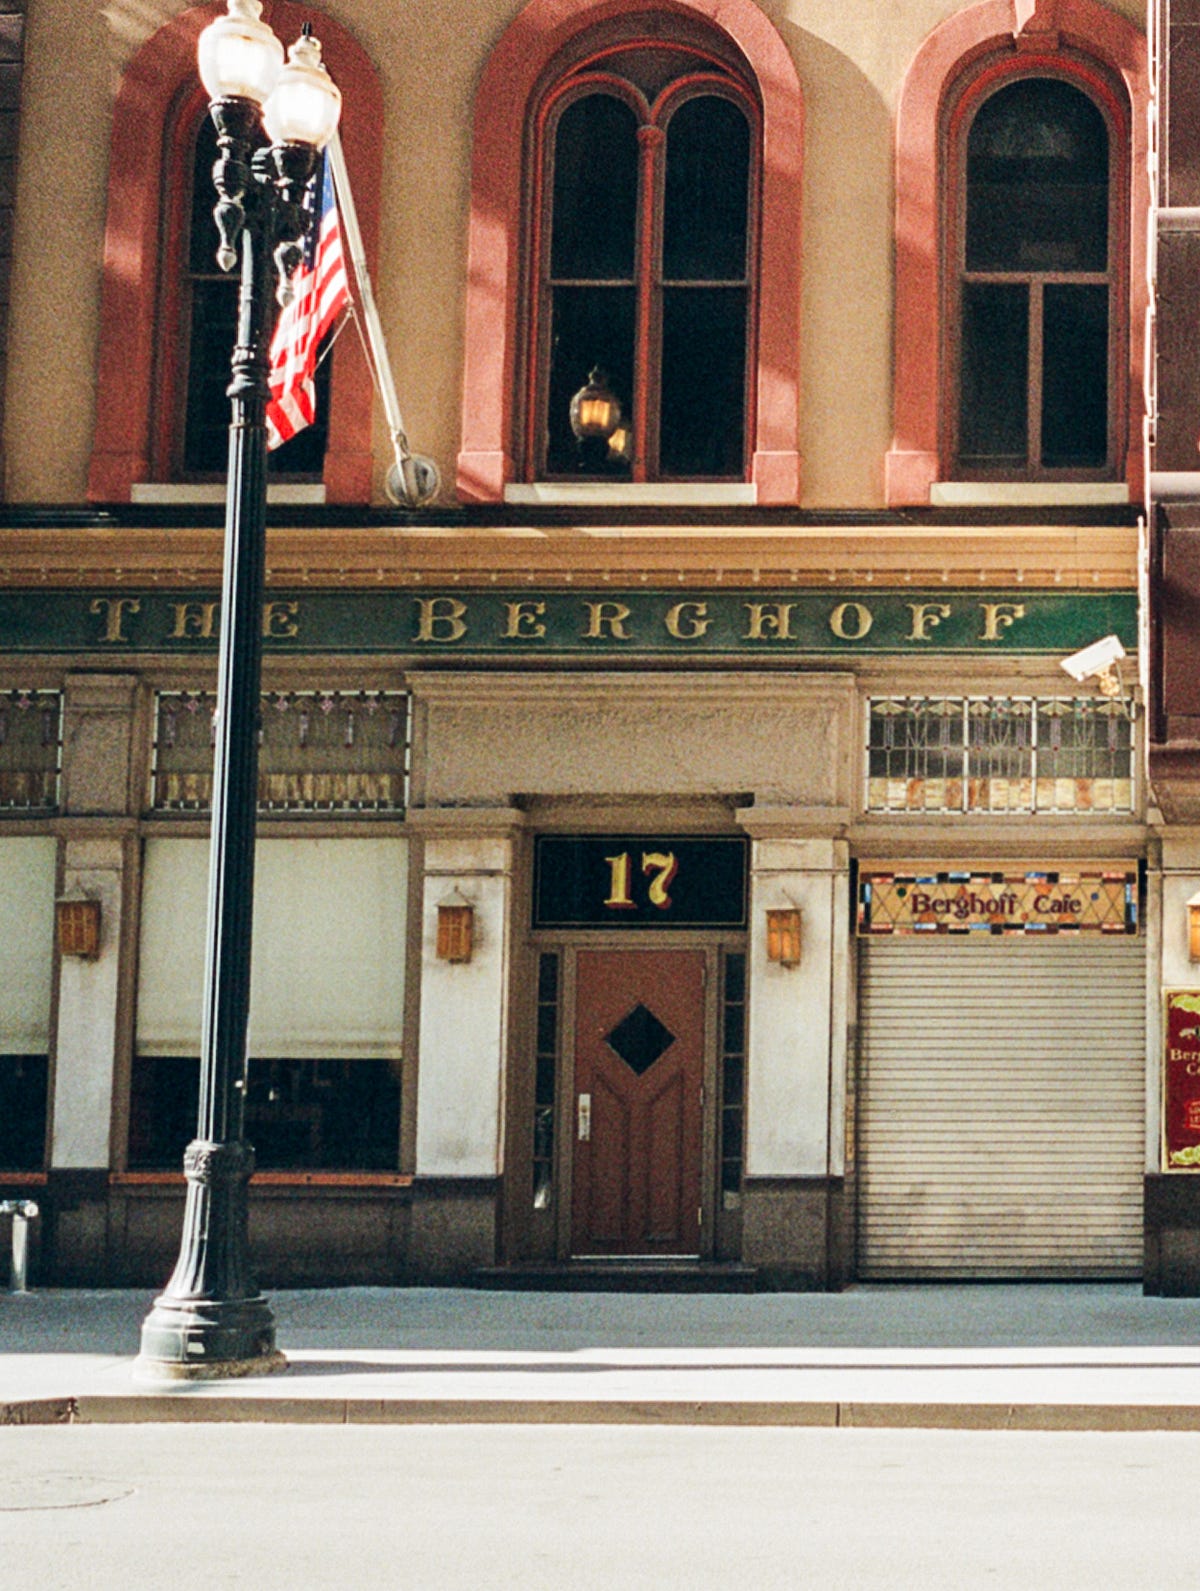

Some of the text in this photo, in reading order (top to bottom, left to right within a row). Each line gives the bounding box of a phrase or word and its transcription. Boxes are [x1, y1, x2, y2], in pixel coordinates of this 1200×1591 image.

[89, 598, 299, 642] THE
[411, 597, 1026, 643] BERGHOFF
[603, 851, 678, 909] 17
[911, 893, 1083, 918] Berghoff Cafe
